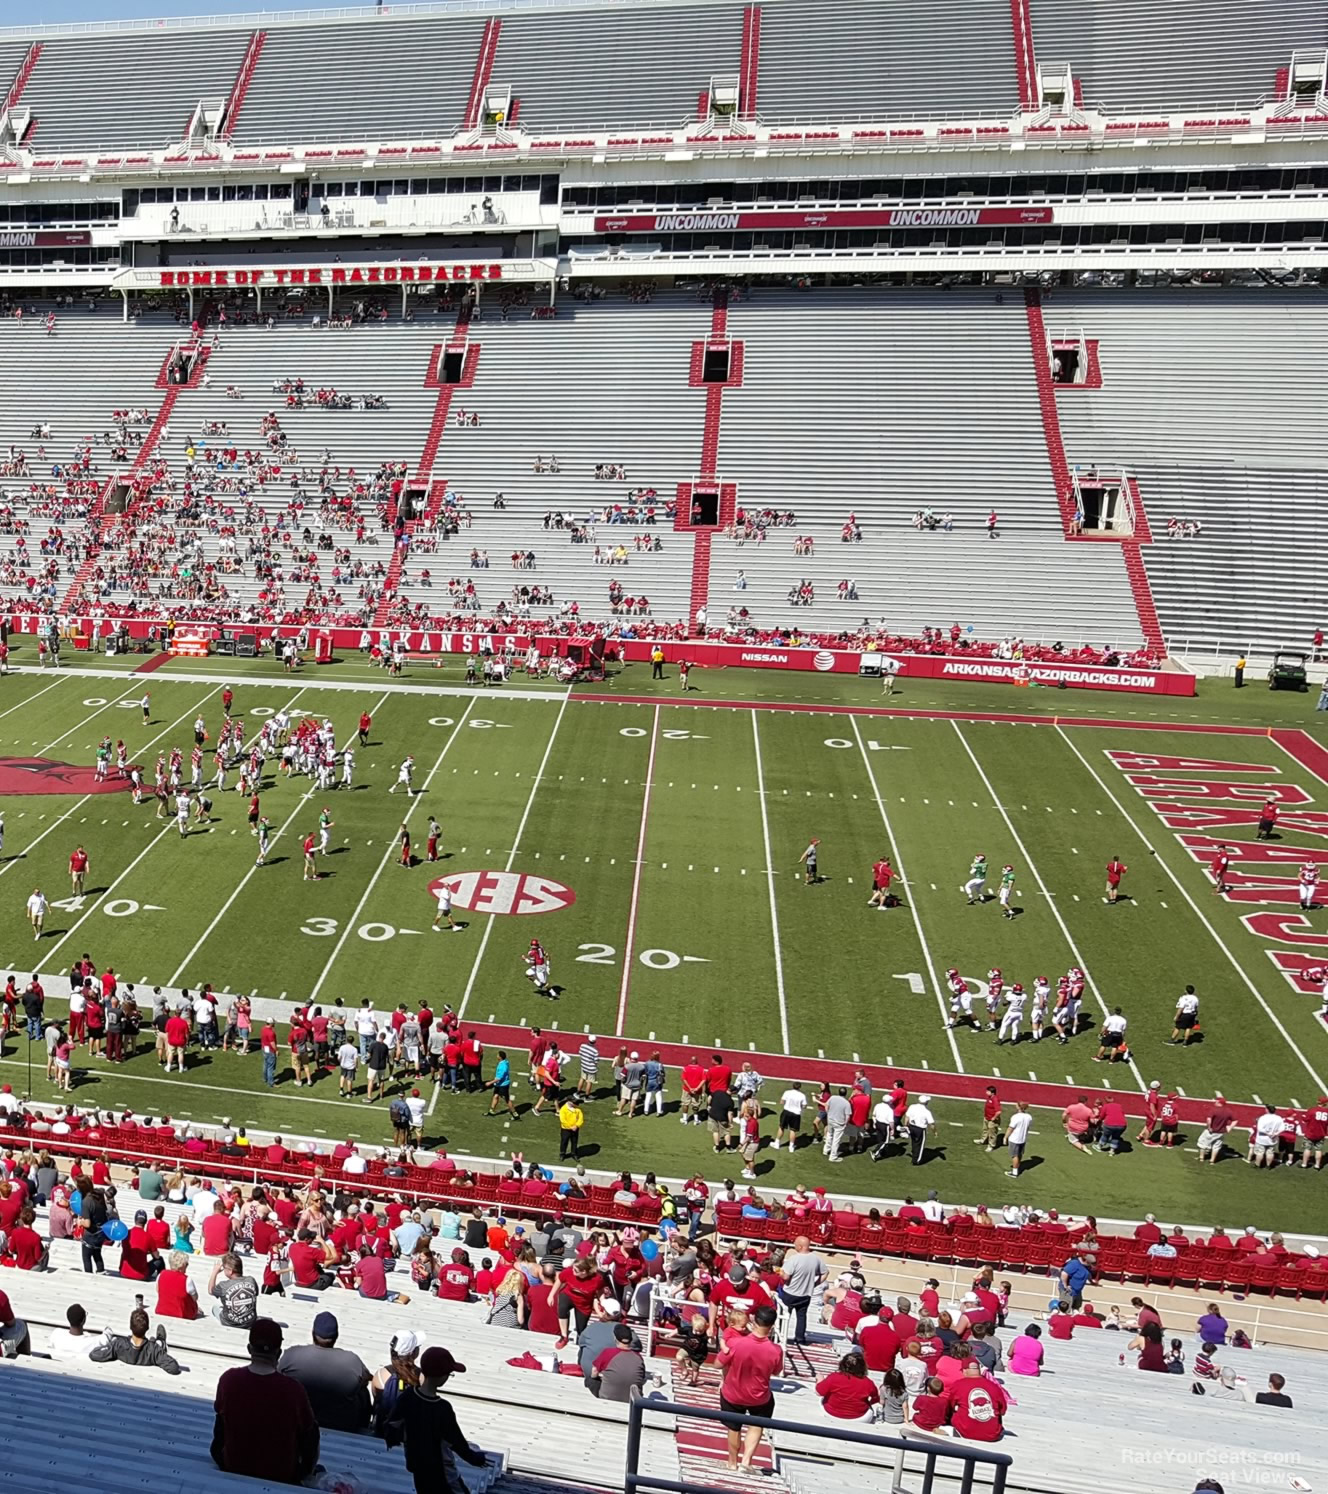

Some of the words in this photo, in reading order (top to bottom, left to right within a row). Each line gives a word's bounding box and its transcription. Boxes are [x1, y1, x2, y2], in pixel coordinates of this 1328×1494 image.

[652, 214, 740, 231] UNCOMMON
[889, 209, 980, 226] UNCOMMON
[160, 270, 228, 286] HOME
[235, 270, 264, 285] OF
[277, 268, 322, 284] THE
[332, 263, 503, 283] RAZORBACKS
[741, 652, 788, 663] NISSAN
[943, 663, 1156, 688] ARKANSASAZORBACKS.COM
[428, 717, 495, 728] 30
[619, 727, 690, 740] 20
[824, 737, 891, 751] 10
[434, 872, 572, 914] SEC
[299, 917, 397, 942] 30
[575, 943, 680, 970] 20
